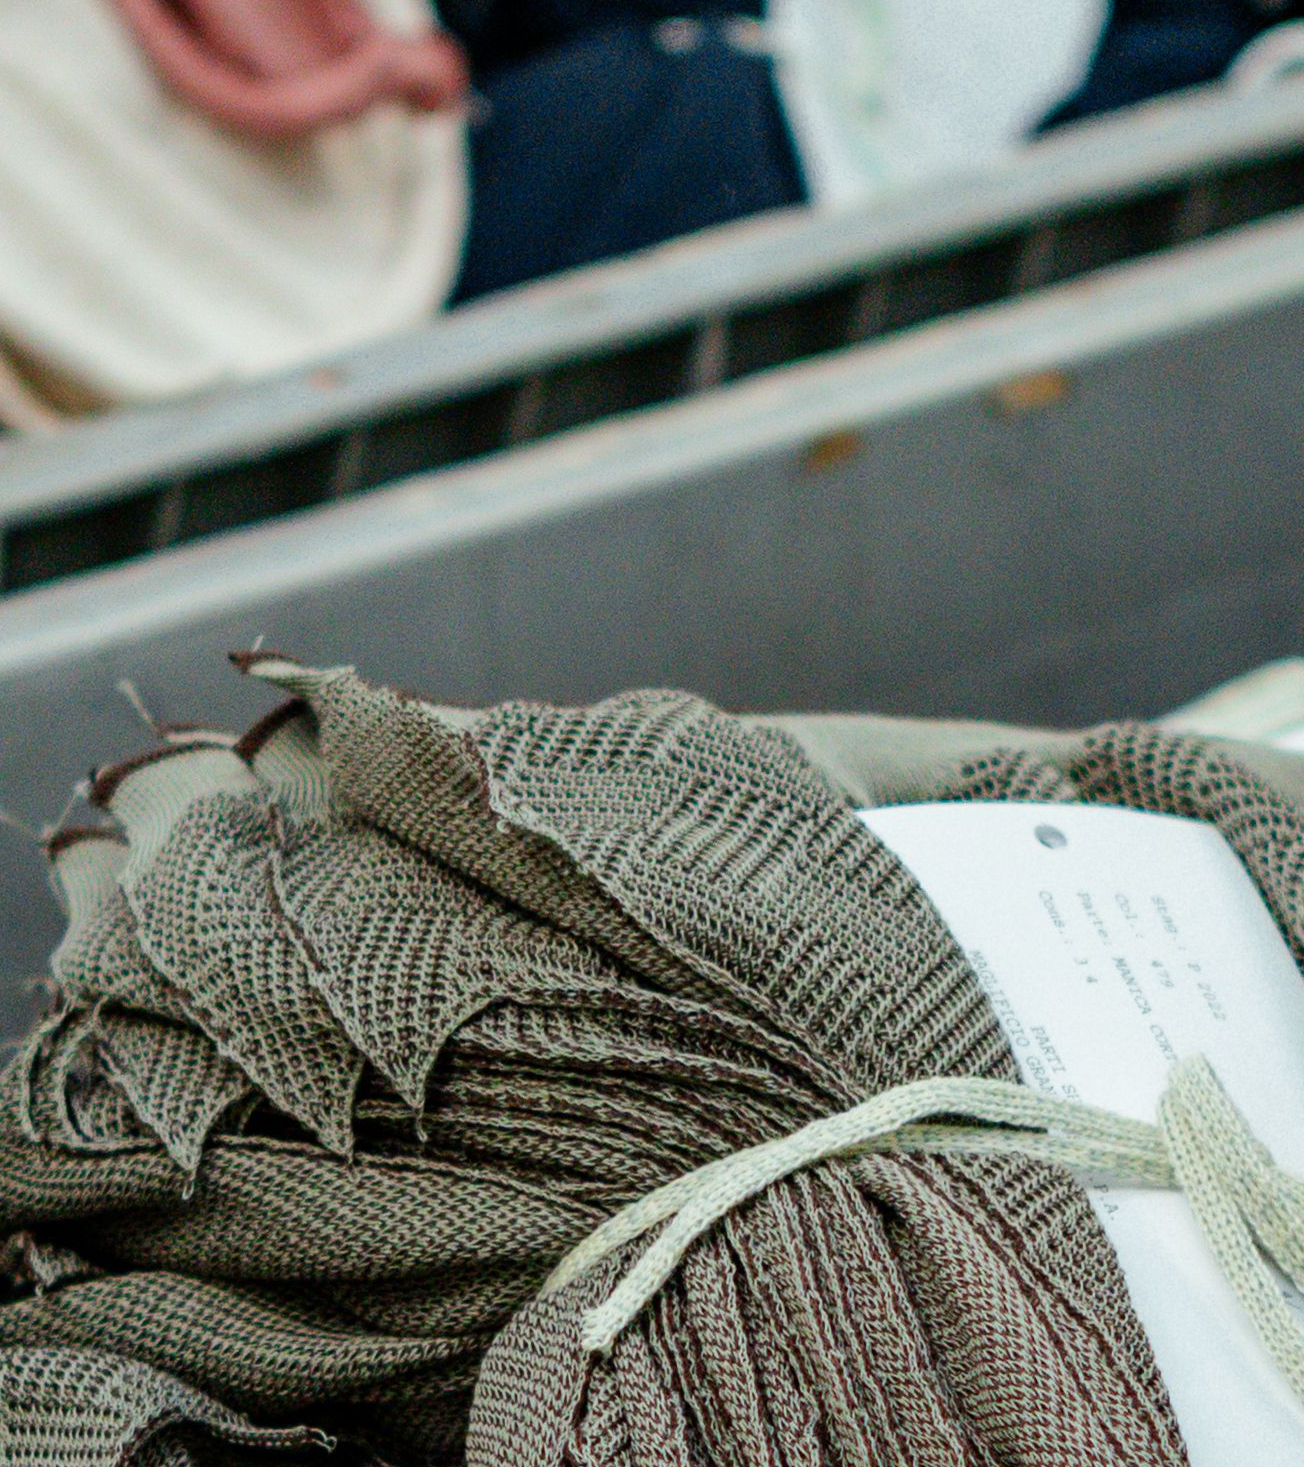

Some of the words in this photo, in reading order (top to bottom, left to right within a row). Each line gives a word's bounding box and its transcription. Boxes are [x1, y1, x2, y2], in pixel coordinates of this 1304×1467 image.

[1112, 957, 1153, 1015] MANICA
[1149, 1024, 1180, 1064] CORT
[1196, 981, 1227, 1022] 2022
[1029, 1025, 1067, 1073] PARTI
